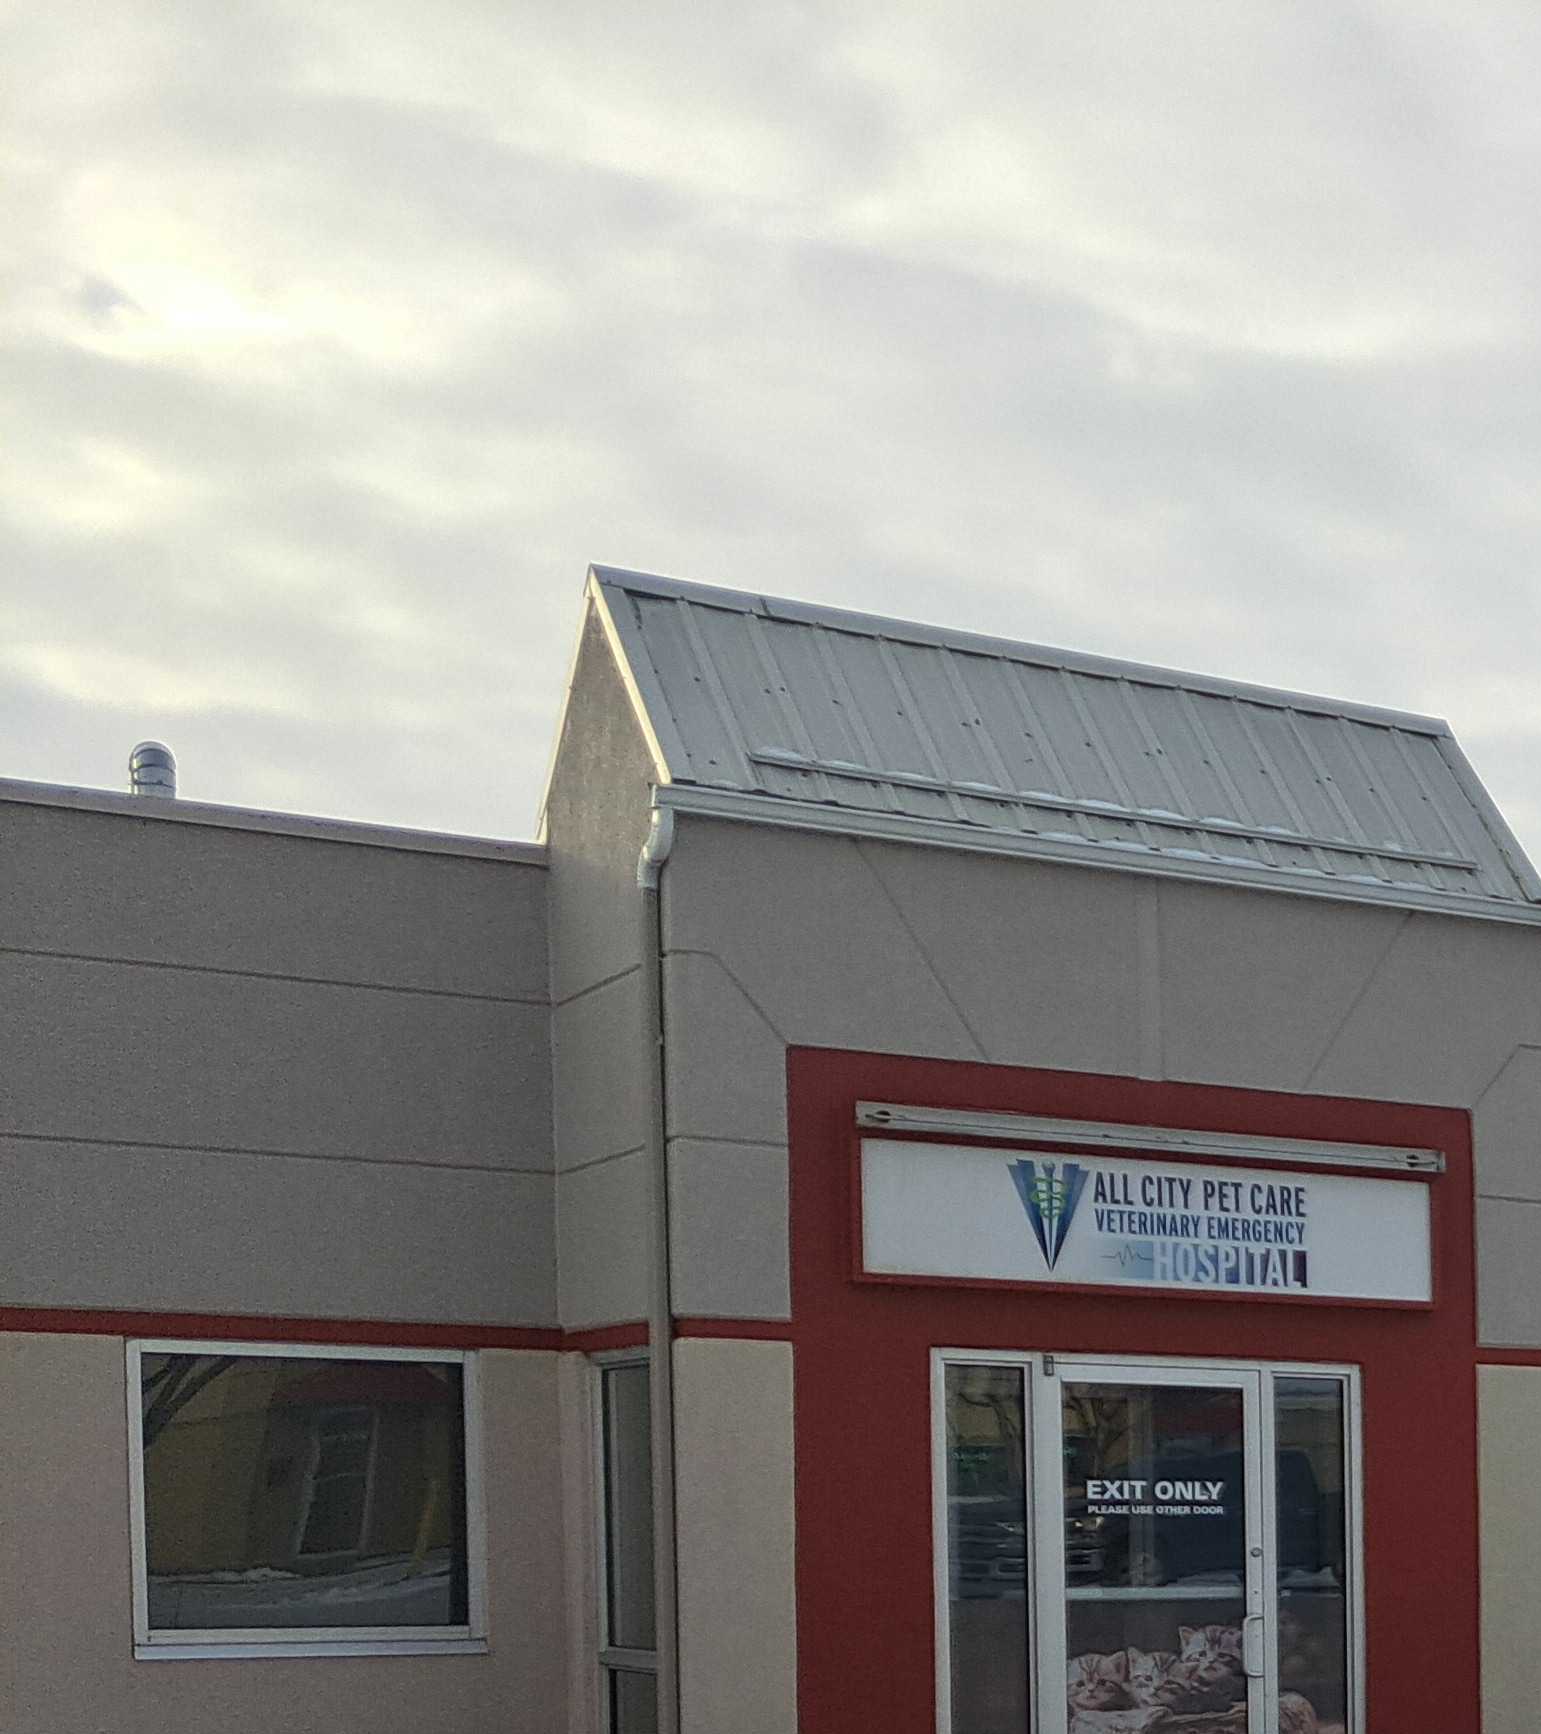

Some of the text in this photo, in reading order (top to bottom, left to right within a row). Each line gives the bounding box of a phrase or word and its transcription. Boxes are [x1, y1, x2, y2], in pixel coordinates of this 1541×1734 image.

[1094, 1171, 1307, 1218] ALL CITY PET CARE
[1094, 1208, 1305, 1245] VETERINARY EMERGENCY
[1152, 1241, 1308, 1289] HOSPITAL
[1086, 1480, 1224, 1500] EXIT ONLY
[1087, 1504, 1224, 1515] PLEASE USE OTHER DOOR
